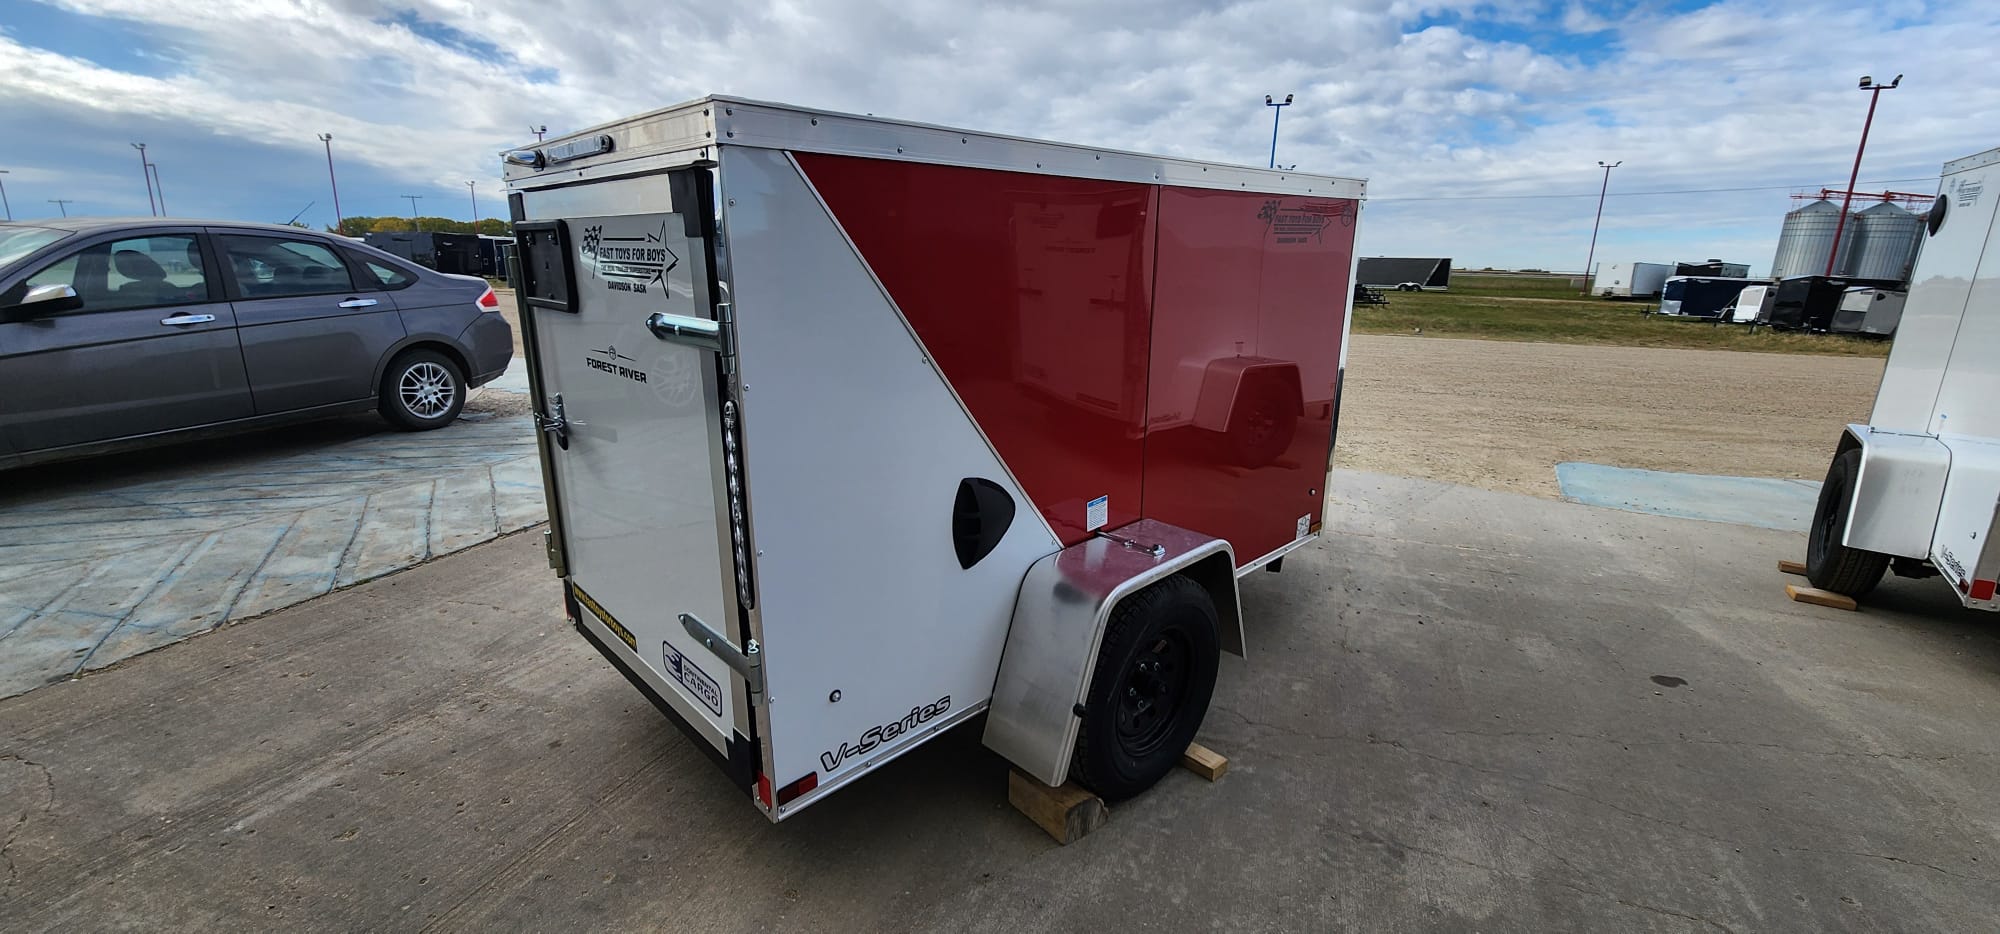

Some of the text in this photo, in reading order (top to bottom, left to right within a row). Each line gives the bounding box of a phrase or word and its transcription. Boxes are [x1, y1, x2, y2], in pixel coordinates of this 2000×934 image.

[599, 247, 666, 262] FAST TOYS FOR BOYS
[608, 281, 647, 294] DAVIDSON SASK
[586, 357, 648, 384] FOREST RIVER
[683, 664, 718, 697] CONTINENTAL
[683, 671, 719, 707] CARGO
[820, 695, 951, 773] V-Series
